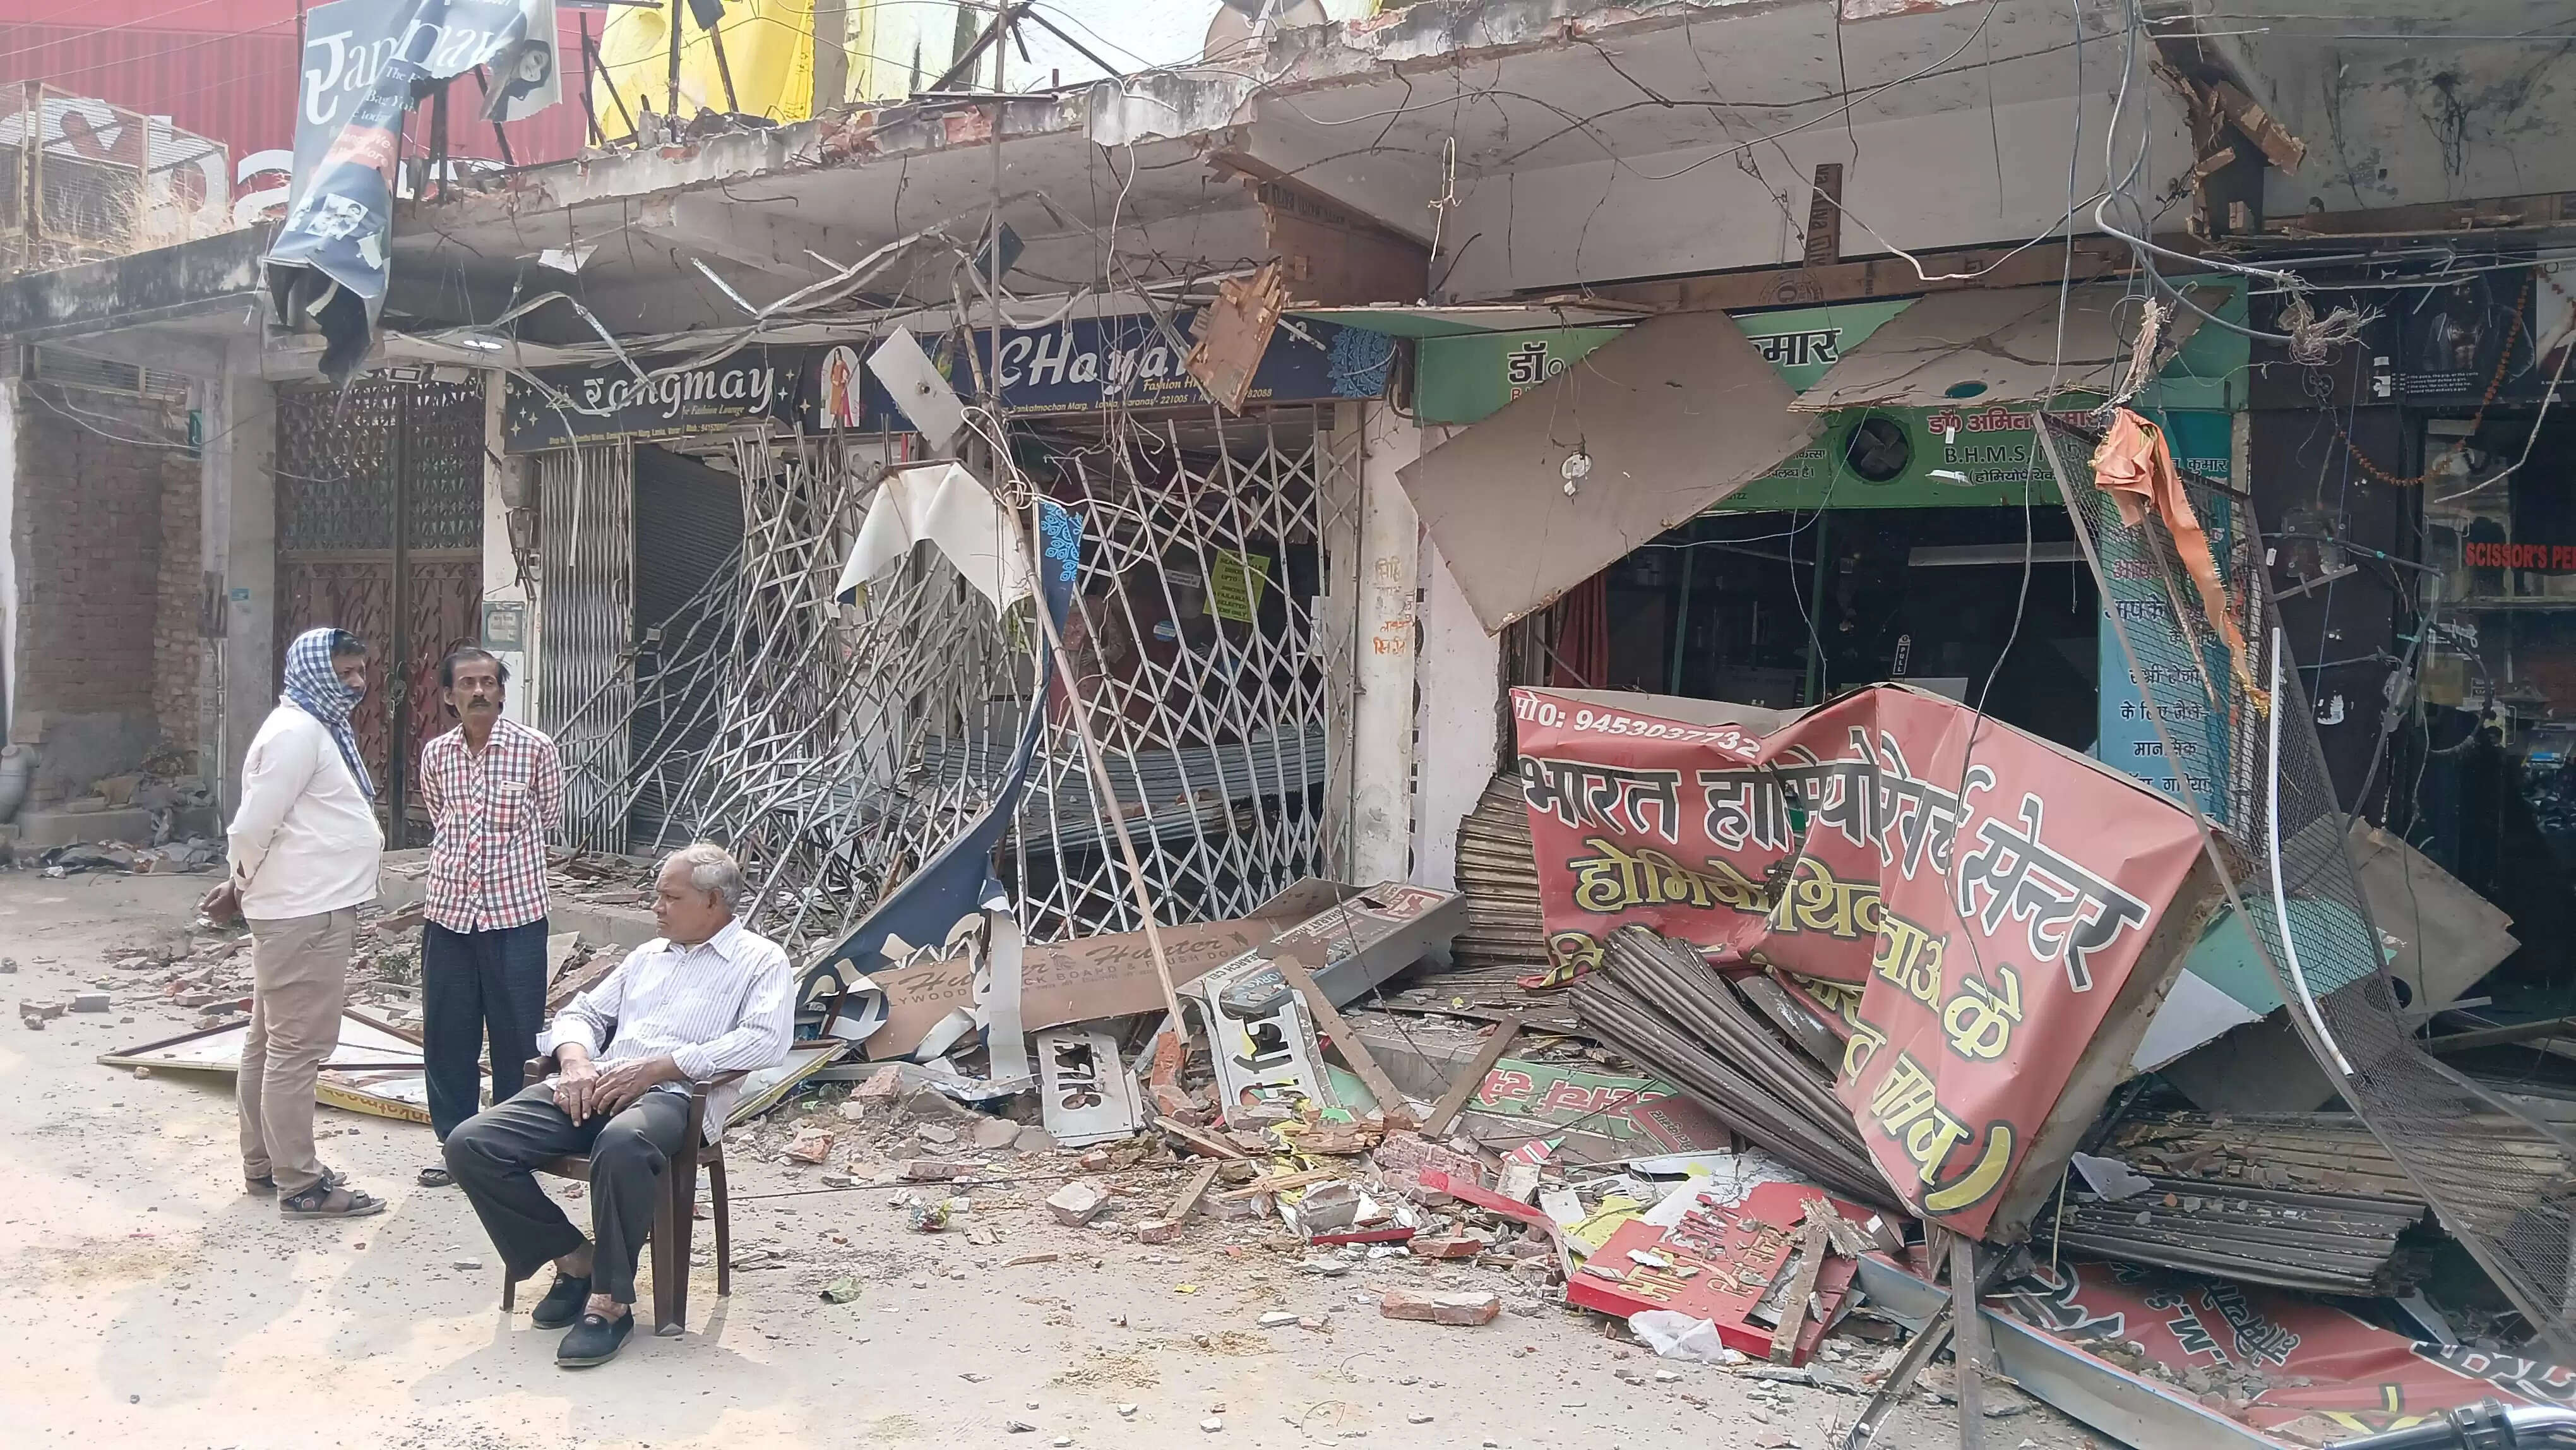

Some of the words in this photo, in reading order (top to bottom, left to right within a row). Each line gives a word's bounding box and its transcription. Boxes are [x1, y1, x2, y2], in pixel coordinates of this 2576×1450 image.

[1748, 328, 1842, 367] मार
[1122, 398, 1154, 407] aranas
[1161, 395, 1188, 404] 221005
[1247, 388, 1272, 398] 82088
[1967, 406, 2033, 433] अमित
[2187, 457, 2229, 477] कुमार
[2466, 542, 2548, 568] SCISSOR'S
[1897, 647, 1905, 672] PULL
[2120, 700, 2136, 720] के
[1573, 709, 1762, 759] 9453037732
[1518, 753, 1681, 845] भारत
[1958, 791, 2151, 993] सेन्टर
[890, 988, 967, 1007] LYWOOD
[1056, 966, 1117, 981] BOARD
[1146, 955, 1198, 968] FUSH
[1244, 973, 1280, 992] ORKS
